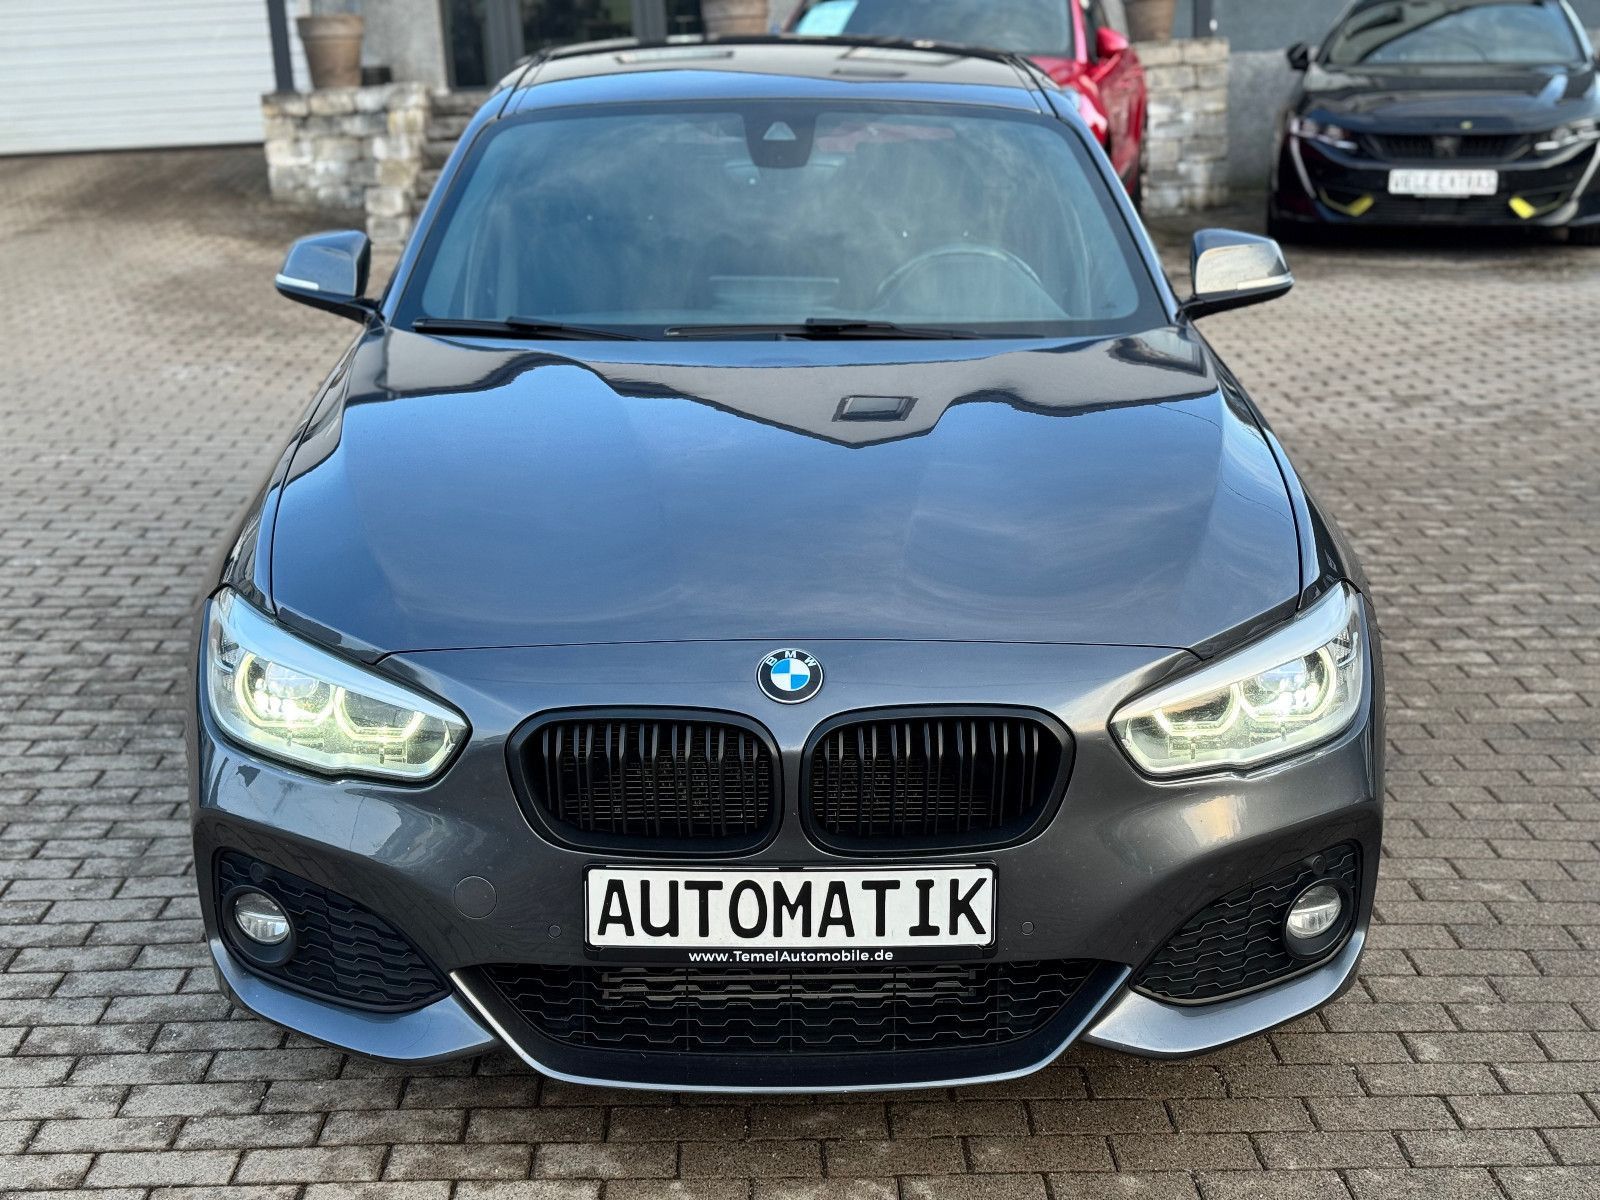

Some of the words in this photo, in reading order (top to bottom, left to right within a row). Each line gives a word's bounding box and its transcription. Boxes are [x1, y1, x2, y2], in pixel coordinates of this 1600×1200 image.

[765, 650, 816, 667] BMW
[597, 877, 987, 939] AUTOMATIK
[688, 949, 894, 962] www.TemelAutomobile.de
